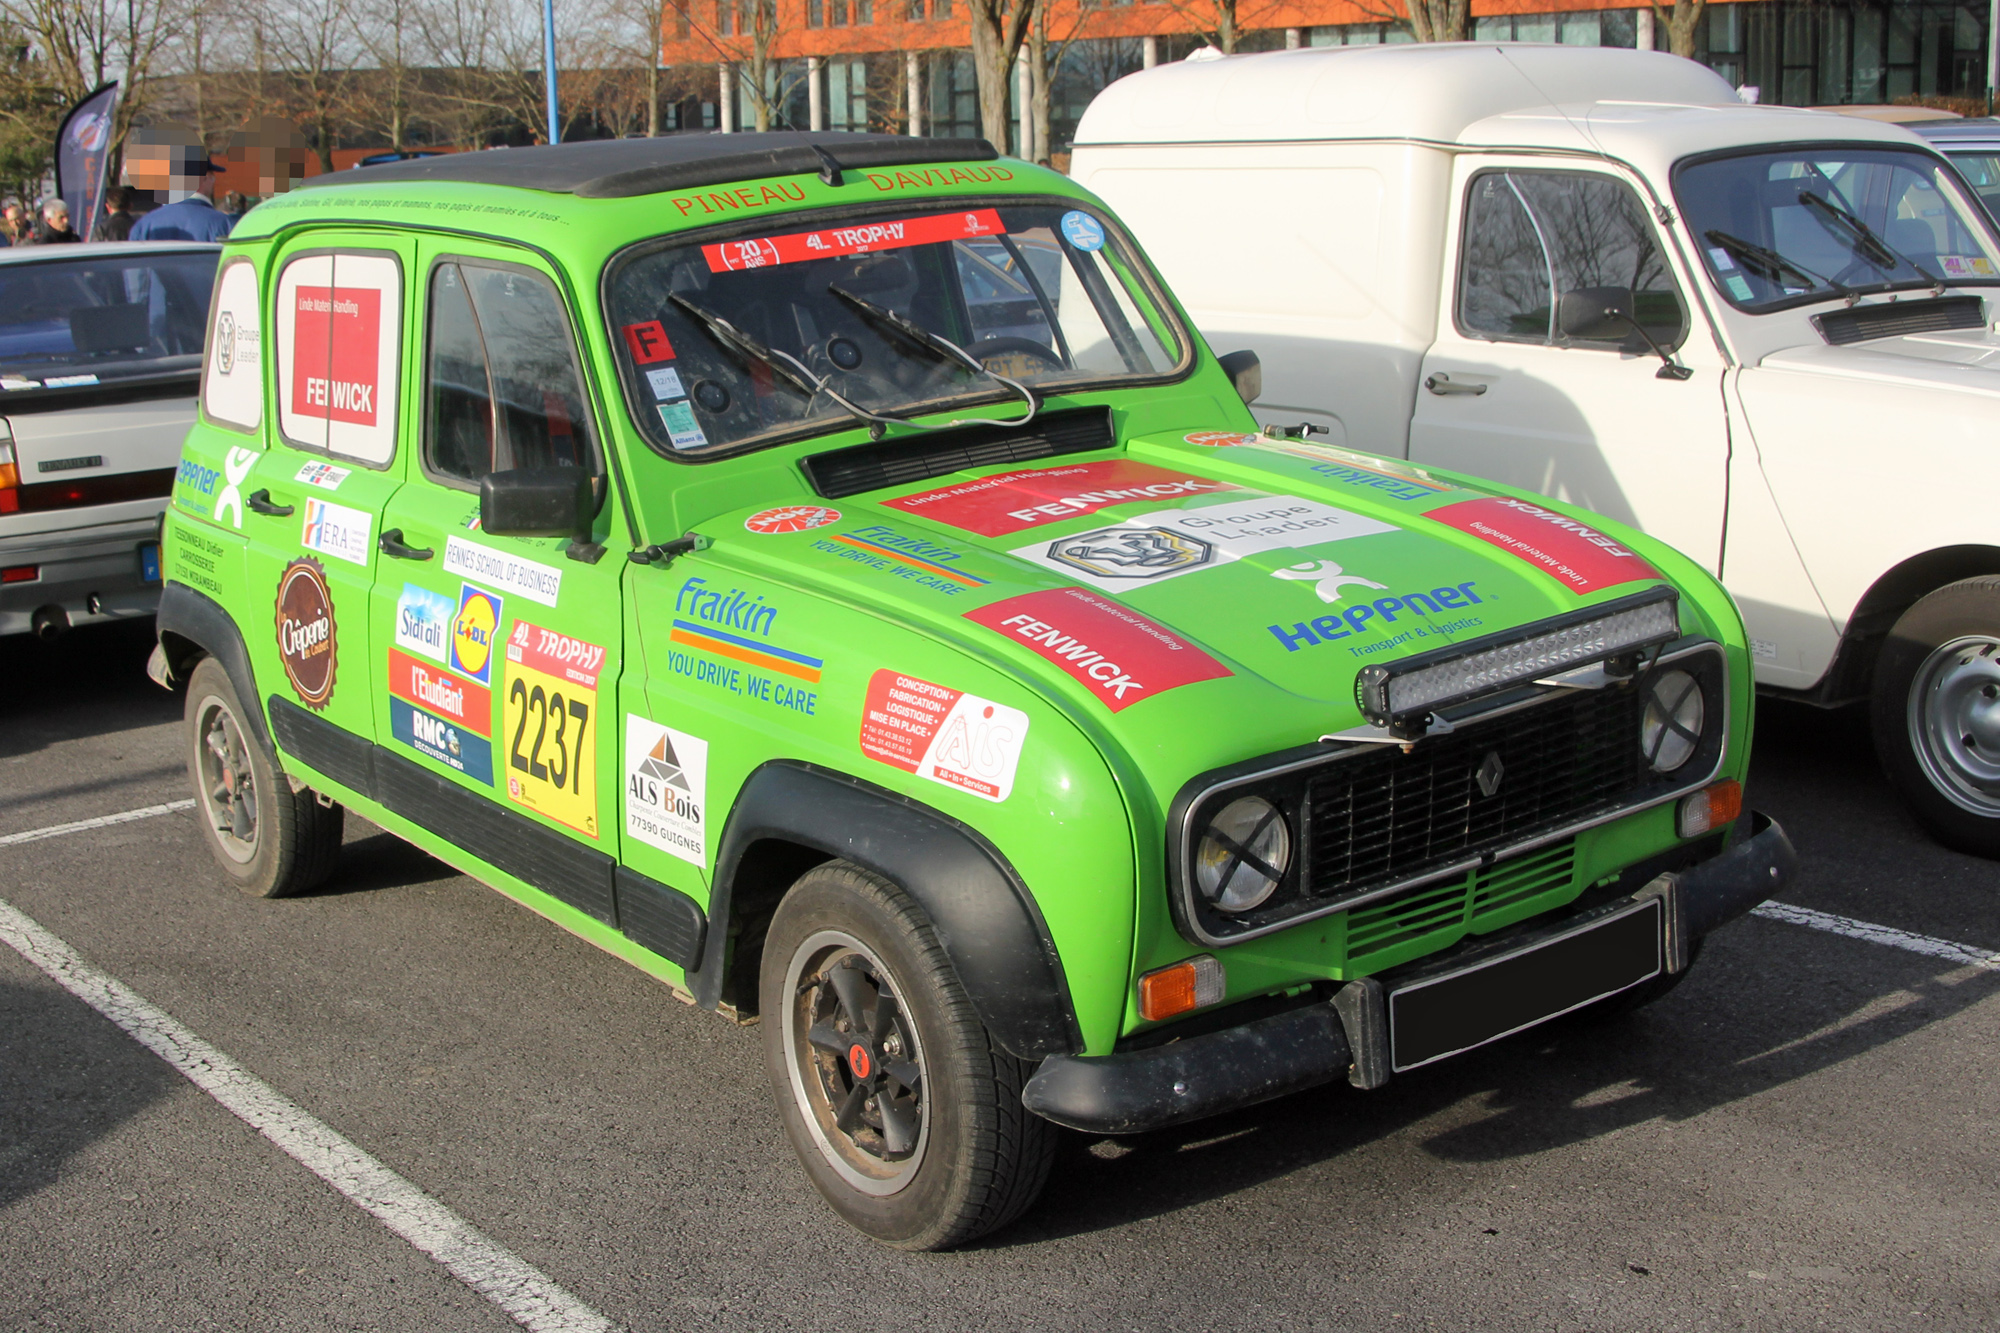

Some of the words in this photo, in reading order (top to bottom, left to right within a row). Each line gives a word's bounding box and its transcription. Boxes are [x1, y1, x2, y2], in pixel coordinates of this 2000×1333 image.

[671, 182, 806, 217] PINEAU
[867, 166, 1014, 191] DAVIAUD
[735, 240, 761, 260] 20
[806, 234, 831, 250] 4L
[832, 222, 904, 247] TROPHY
[744, 256, 766, 269] ANS
[634, 326, 658, 358] F
[904, 491, 951, 506] Linde
[951, 475, 1017, 496] Material
[1310, 463, 1432, 501] Fraikin
[752, 508, 816, 527] NGK
[1007, 480, 1217, 522] FENWICK
[1178, 506, 1312, 529] Groupe
[851, 525, 962, 562] Fraikin
[1209, 516, 1339, 540] Leader
[1469, 521, 1516, 544] Handling
[1497, 499, 1634, 558] FENWICK
[446, 543, 475, 570] RENNES
[475, 553, 503, 580] SCHOOL
[506, 562, 518, 583] OF
[518, 566, 558, 597] BUSINESS
[809, 539, 844, 557] YOU
[838, 549, 891, 571] DRIVE,
[889, 565, 922, 580] WE
[915, 574, 967, 596] CARE
[1511, 541, 1560, 567] Material
[1558, 565, 1589, 587] Linde
[675, 576, 777, 637] Fraikin
[1065, 588, 1095, 604] Linde
[1092, 601, 1137, 625] Material
[1135, 619, 1184, 651] Handling
[401, 608, 424, 641] Sidi
[424, 621, 441, 648] ali
[513, 622, 530, 648] 4L
[536, 629, 603, 671] TROPHY
[1348, 630, 1414, 658] Transport
[1414, 627, 1427, 638] &
[1431, 615, 1483, 636] Logistics
[1001, 613, 1144, 700] FENWICK
[668, 650, 694, 677] YOU
[697, 659, 743, 697] DRIVE,
[747, 673, 772, 702] WE
[774, 683, 818, 716] CARE
[889, 688, 941, 713] FABRICATION
[896, 676, 949, 701] CONCEPTION
[413, 709, 446, 750] RMC
[870, 710, 888, 724] MISE
[889, 716, 900, 729] EN
[901, 719, 927, 737] PLACE
[886, 701, 933, 725] LOGISTIQUE
[510, 677, 588, 796] 2237
[629, 773, 658, 806] ALS
[664, 787, 700, 824] Bois
[939, 768, 949, 779] All
[952, 771, 959, 782] In
[963, 777, 991, 793] Services
[631, 815, 658, 836] 77390
[660, 826, 701, 854] GUIGNES
